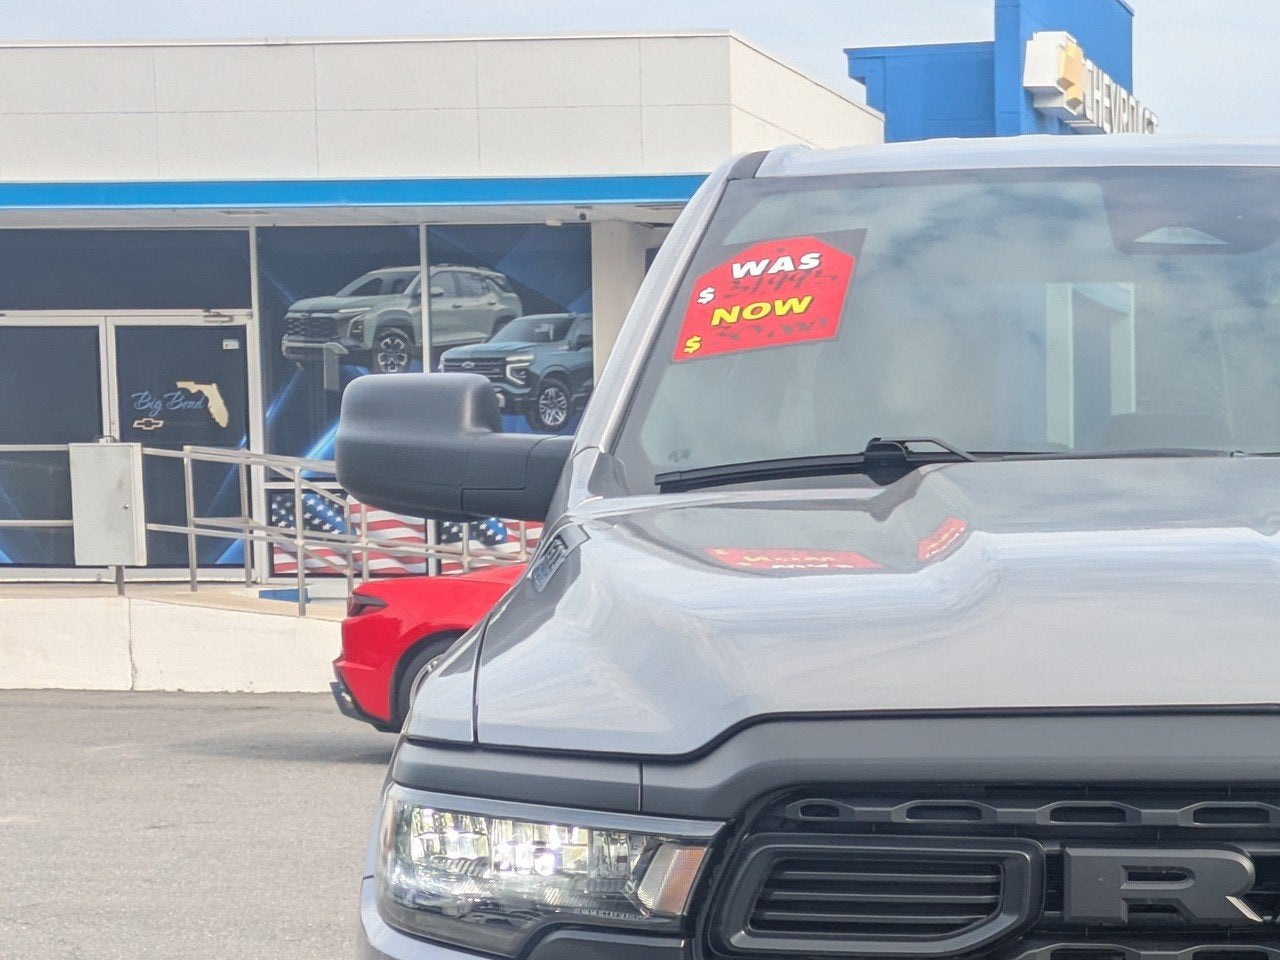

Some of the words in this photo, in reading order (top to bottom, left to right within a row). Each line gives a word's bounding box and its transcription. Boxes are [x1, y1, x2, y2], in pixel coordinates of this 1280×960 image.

[731, 252, 822, 280] WAS
[710, 295, 813, 327] NOW
[131, 391, 162, 417] Big
